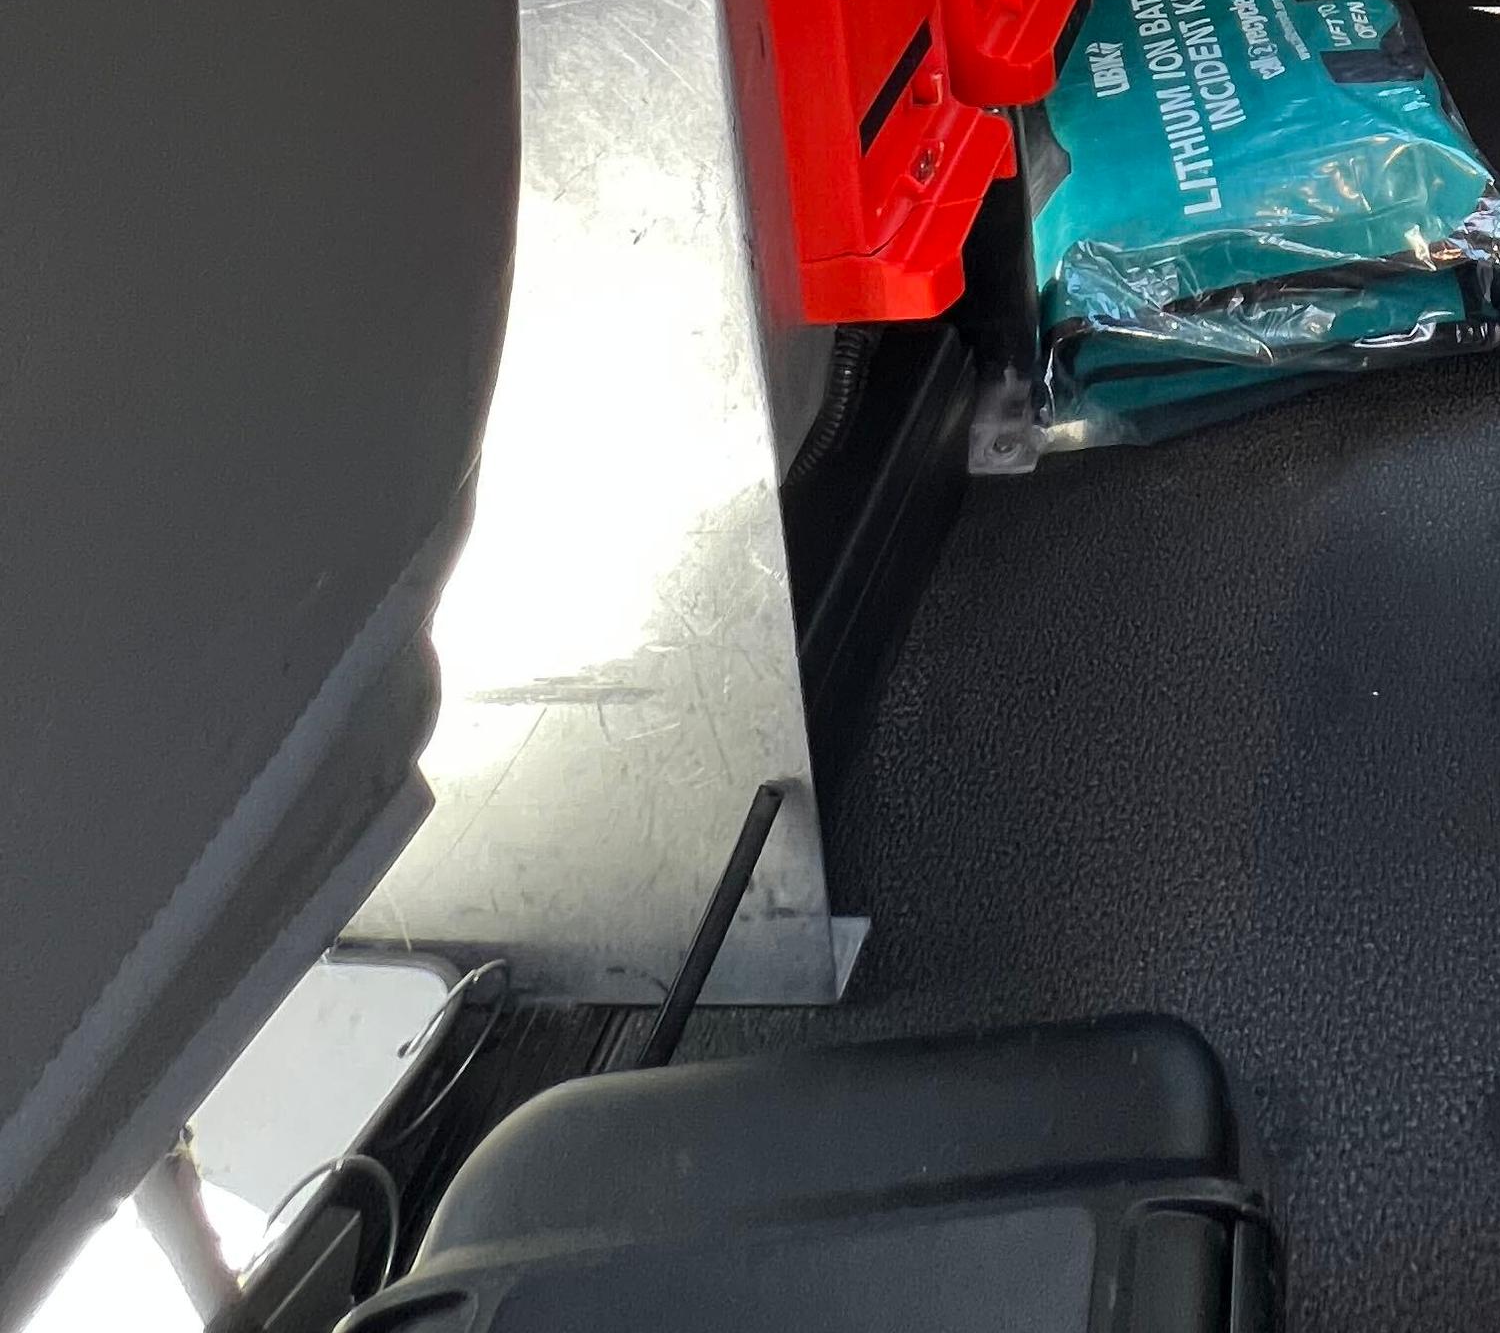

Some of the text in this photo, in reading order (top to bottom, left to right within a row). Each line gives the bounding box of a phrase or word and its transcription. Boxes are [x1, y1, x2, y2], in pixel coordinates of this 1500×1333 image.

[1317, 3, 1351, 47] LIFT TO
[1346, 1, 1378, 39] OPEN
[1143, 38, 1186, 80] ION
[1179, 17, 1246, 131] INCIDENT
[1156, 85, 1222, 215] LITHIUM
